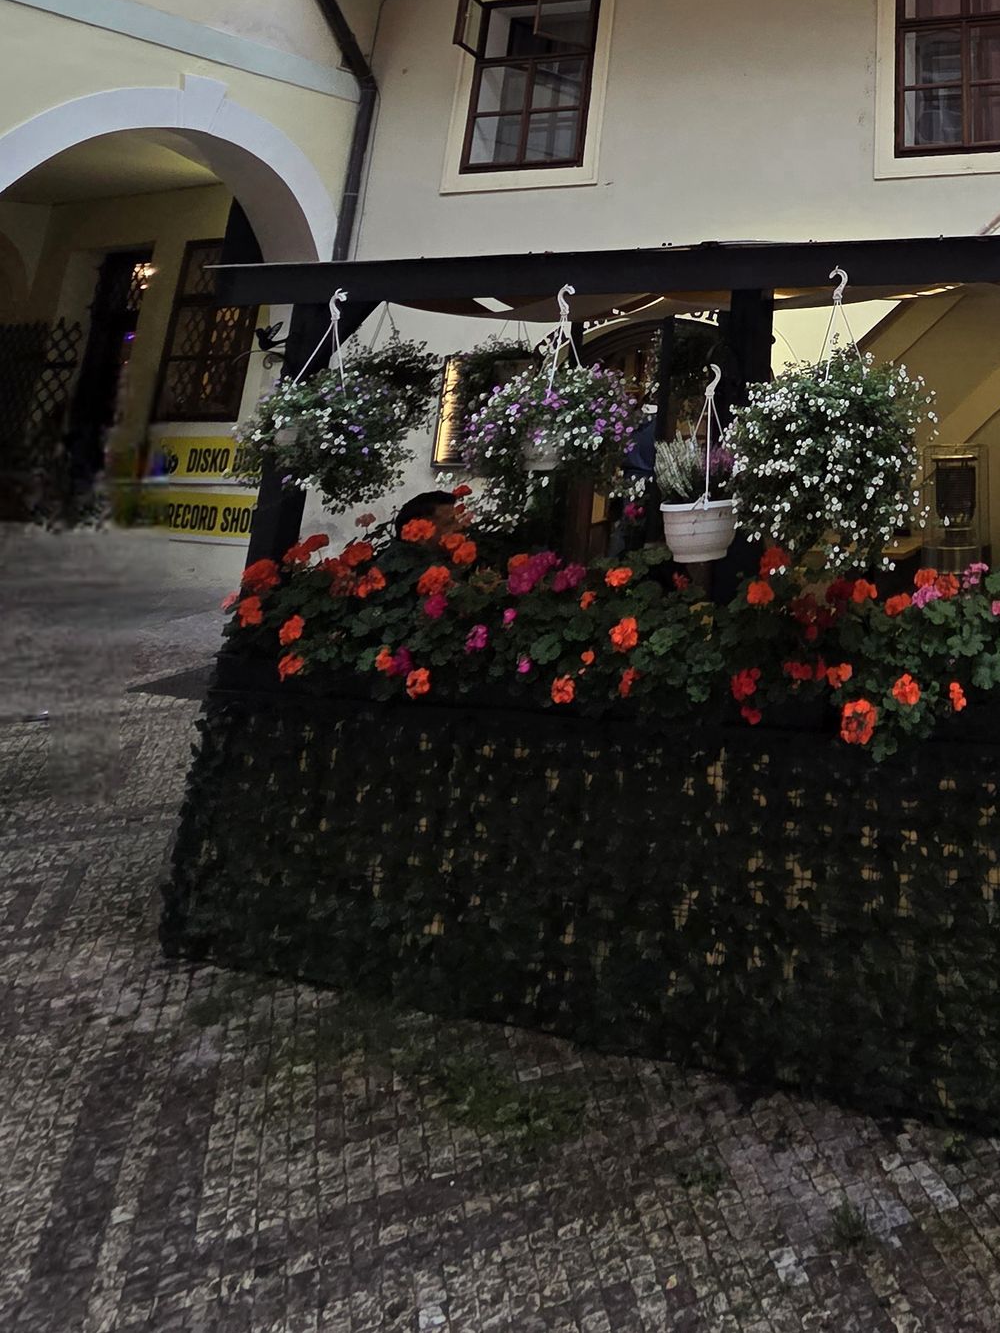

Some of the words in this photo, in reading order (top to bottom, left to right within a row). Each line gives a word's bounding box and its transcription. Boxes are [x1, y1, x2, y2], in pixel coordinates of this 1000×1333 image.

[186, 448, 230, 473] DISKO
[168, 504, 218, 531] RECORD
[220, 507, 253, 534] SHO
